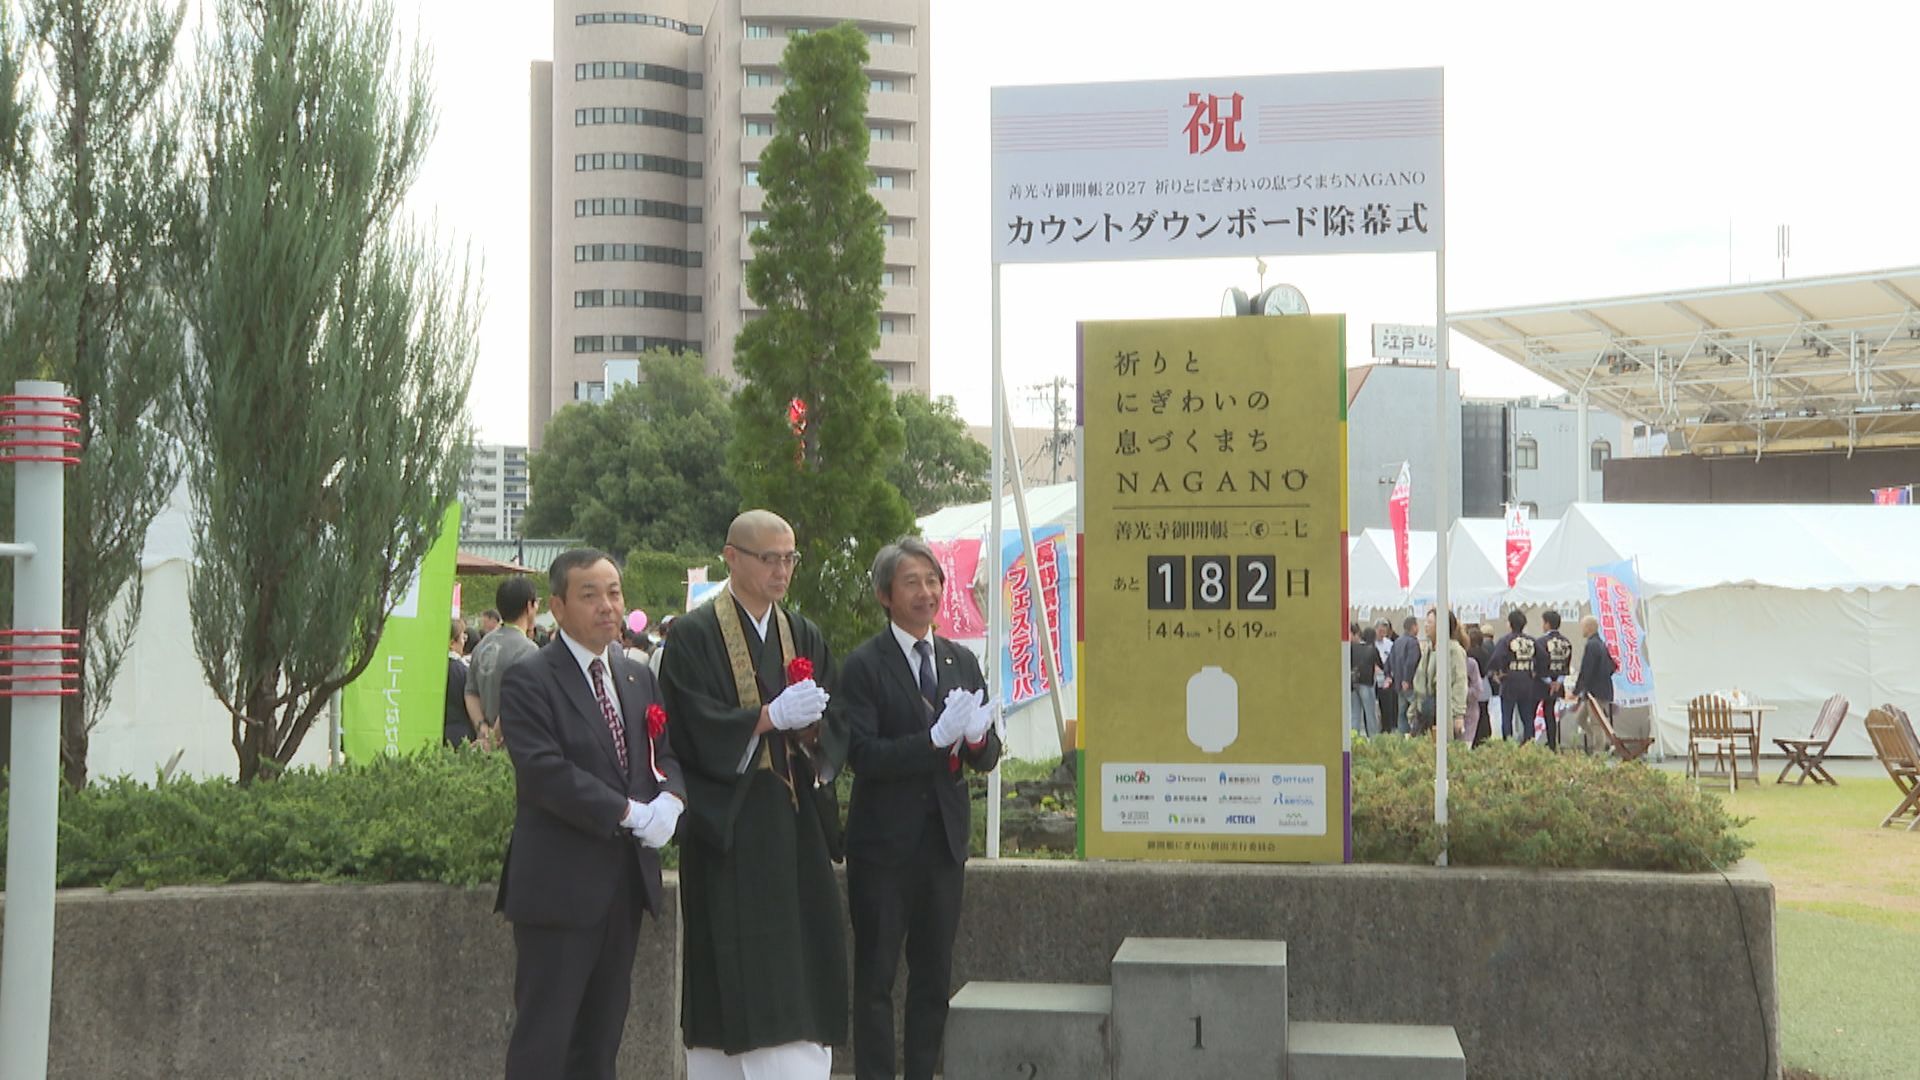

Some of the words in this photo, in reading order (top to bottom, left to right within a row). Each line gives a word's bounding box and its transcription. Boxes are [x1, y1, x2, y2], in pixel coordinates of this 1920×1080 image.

[1182, 91, 1246, 155] 祝
[1009, 180, 1146, 200] 善光寺御開帳2027
[1155, 171, 1426, 196] 祈りとにぎわいの息づくまちNAGANO
[1008, 201, 1428, 246] カウントダウンボード除幕式
[1114, 350, 1200, 377] 祈りと
[1116, 389, 1270, 414] にぎわいの
[1115, 429, 1269, 456] 息づくまち
[1117, 469, 1309, 494] NAGANO
[1113, 576, 1140, 591] あと
[1286, 568, 1309, 597] 日
[1190, 1015, 1204, 1050] 1
